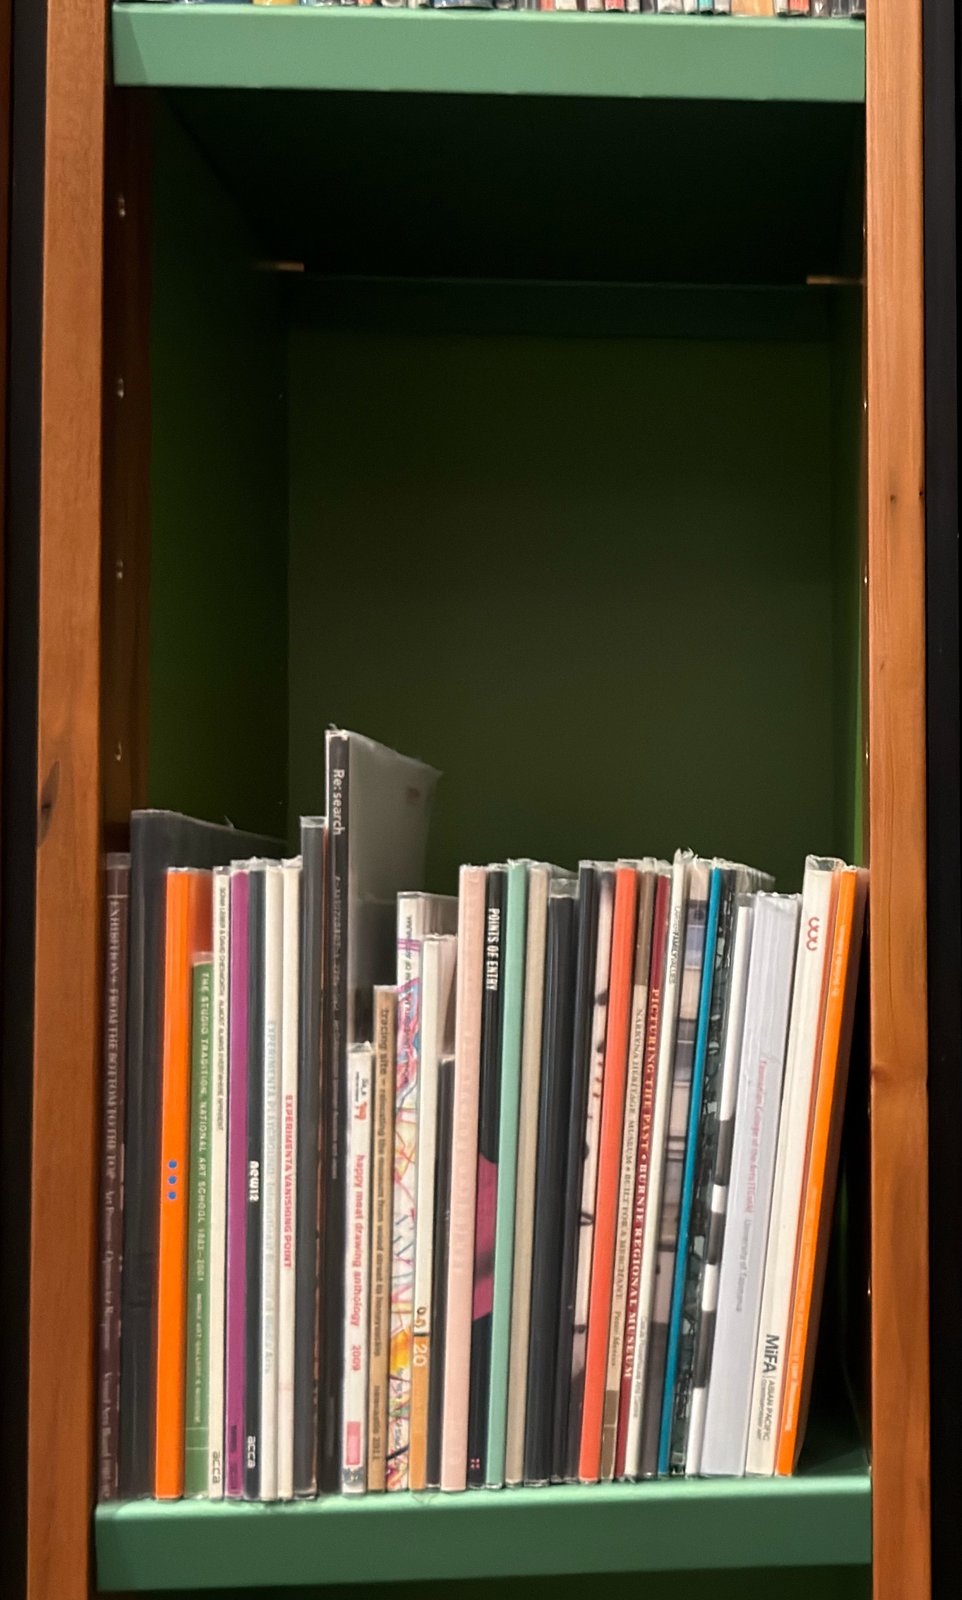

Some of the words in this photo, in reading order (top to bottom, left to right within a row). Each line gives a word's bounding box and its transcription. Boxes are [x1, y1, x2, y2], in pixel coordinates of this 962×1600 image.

[487, 907, 500, 943] POINTS
[487, 944, 499, 959] OF
[200, 973, 210, 991] THE
[486, 960, 499, 991] ENTRY
[199, 996, 209, 1034] STUDIO
[378, 1007, 390, 1050] tracing
[646, 988, 660, 1074] PICTURING
[266, 1020, 276, 1098] EXPERIMENTA
[379, 1053, 389, 1075] site
[643, 1079, 654, 1109] THE
[198, 1101, 207, 1152] NATIONAL
[284, 1094, 294, 1172] EXPERIMENTA
[640, 1113, 651, 1151] PAST
[751, 1106, 762, 1137] College
[377, 1139, 386, 1154] the
[625, 1119, 637, 1165] MUSEUM
[197, 1157, 206, 1177] ART
[354, 1154, 366, 1188] happy
[196, 1181, 206, 1223] SCHOOL
[283, 1173, 293, 1233] VANISHING
[635, 1163, 647, 1223] BURNIE
[283, 1234, 292, 1268] POINT
[351, 1222, 364, 1267] drawing
[629, 1227, 642, 1307] REGIONAL
[350, 1270, 363, 1327] anthology
[351, 1344, 362, 1372] 2009
[412, 1343, 428, 1367] 20
[624, 1311, 636, 1378] MUSEUM
[762, 1334, 780, 1374] MiFA
[766, 1380, 776, 1406] ASIAN
[763, 1407, 774, 1441] PACIFIC
[211, 1450, 221, 1484] acca
[246, 1435, 256, 1469] acca
